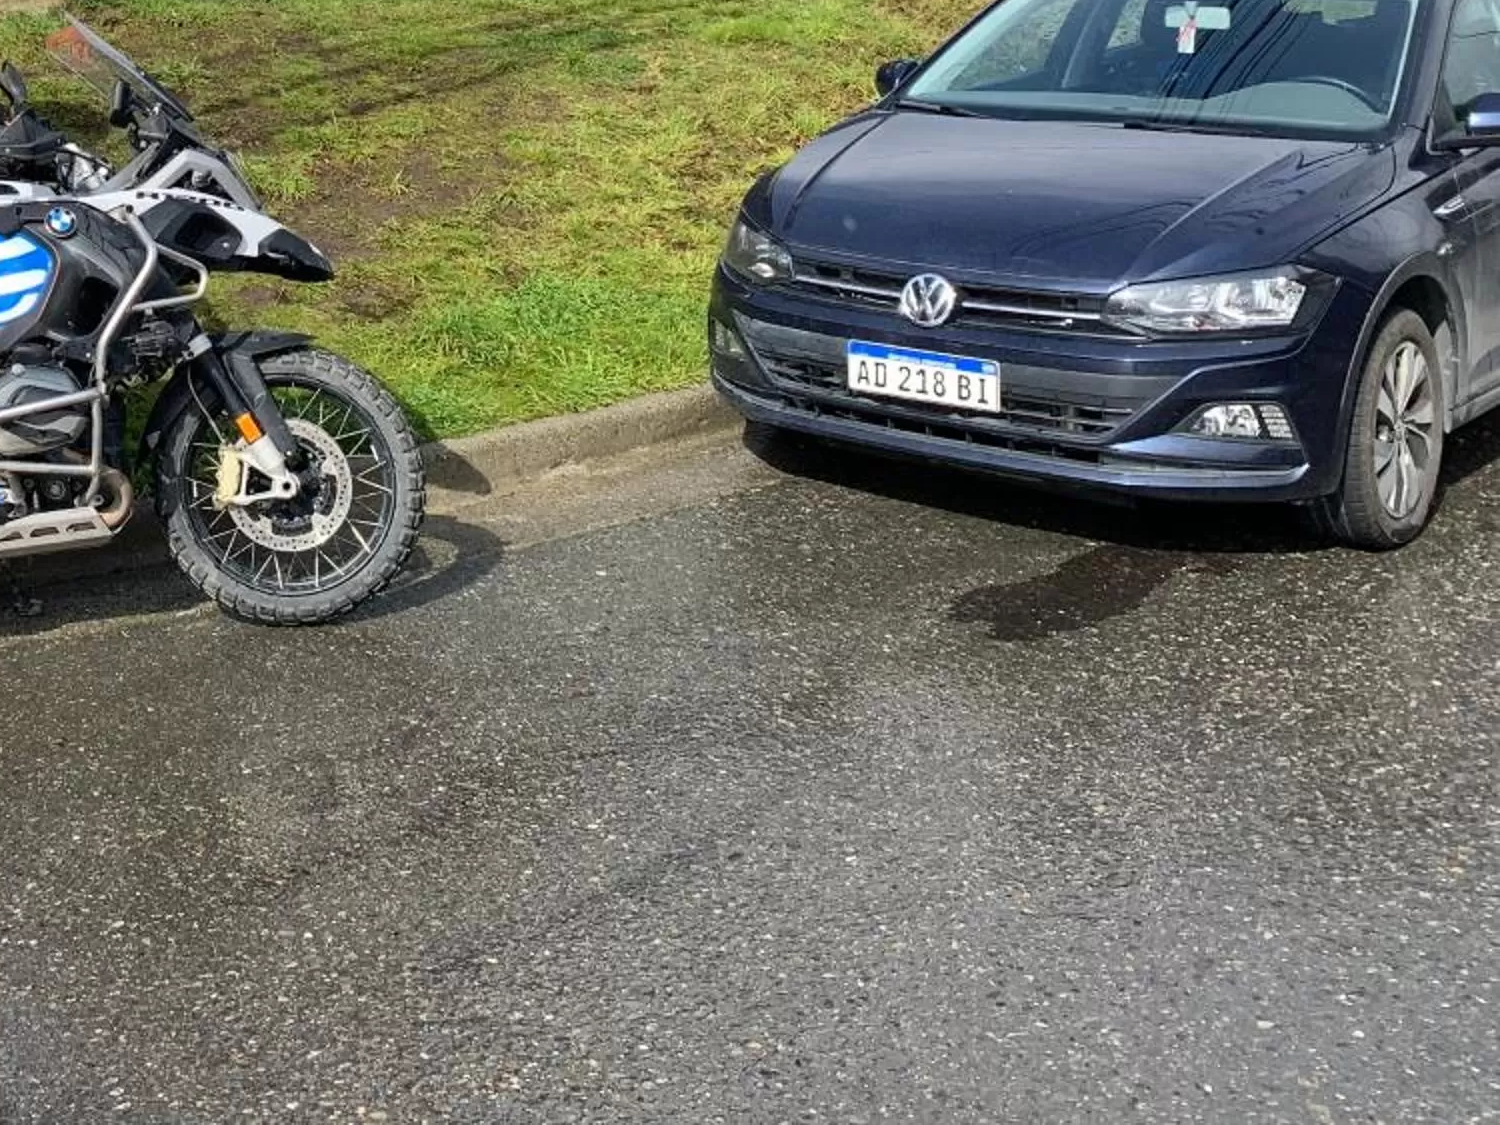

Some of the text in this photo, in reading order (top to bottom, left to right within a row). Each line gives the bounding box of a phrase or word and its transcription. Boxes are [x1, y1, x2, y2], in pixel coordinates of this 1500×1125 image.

[857, 360, 887, 388] AD
[898, 366, 947, 397] 218
[957, 374, 989, 404] BI
